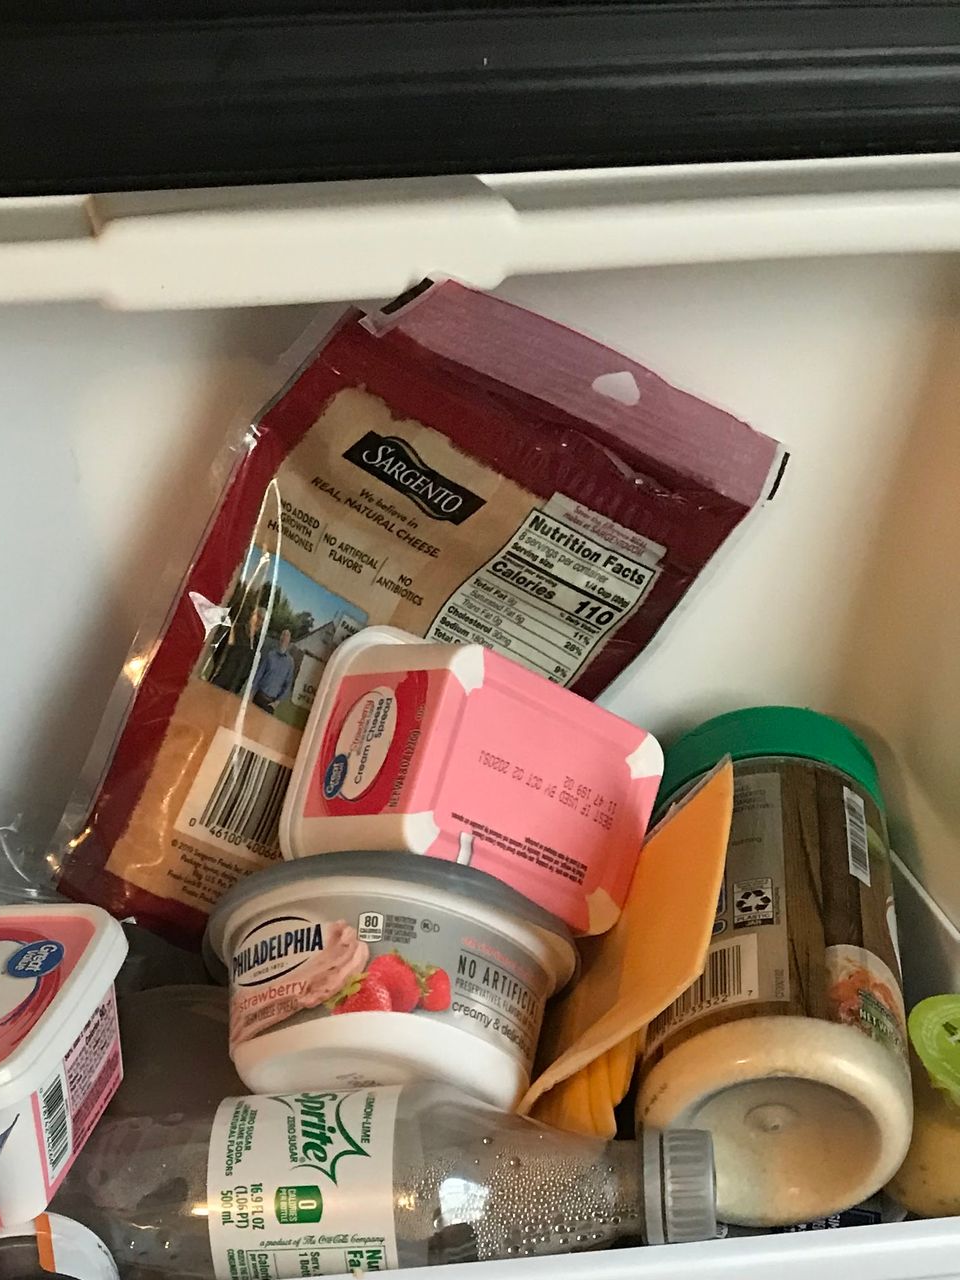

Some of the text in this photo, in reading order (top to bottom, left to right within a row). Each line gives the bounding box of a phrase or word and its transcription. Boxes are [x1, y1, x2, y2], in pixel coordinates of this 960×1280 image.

[362, 444, 463, 513] SARGENTO
[280, 498, 320, 529] NO ADDED
[344, 498, 395, 533] NATURAL
[359, 488, 418, 529] We believe in
[280, 513, 312, 537] GROWTH
[323, 533, 379, 570] NO ARTIFICIAL
[328, 550, 363, 574] FLAVORS
[518, 532, 609, 583] 8 servings per container
[529, 515, 646, 585] Nutrition Facts
[398, 574, 413, 587] NO
[511, 542, 613, 599] Serving size 1/4 Cup
[376, 577, 424, 606] ANTIBIOTICS
[473, 578, 493, 592] Total
[492, 589, 508, 600] Fat
[492, 561, 614, 626] Calories 110
[480, 607, 494, 619] Fat
[502, 606, 516, 617] Fat
[433, 628, 453, 643] Total
[440, 616, 470, 637] Sodium
[447, 605, 492, 634] Cholesterol
[553, 666, 568, 678] 9%
[375, 698, 392, 738] Spread
[354, 699, 384, 784] Cream Cheese
[512, 766, 524, 781] 02
[525, 774, 543, 790] OCT
[558, 790, 579, 809] USED
[189, 818, 197, 827] 0
[209, 828, 242, 846] 46100
[364, 916, 378, 927] 80
[232, 923, 323, 983] PHILADELPHIA
[457, 955, 476, 978] NO
[239, 980, 307, 1013] strawberry
[451, 1002, 500, 1030] creamy &
[244, 1109, 258, 1151] ZERO SUGAR
[287, 1116, 298, 1163] ZERO SUGAR
[295, 1092, 337, 1163] Sprite
[225, 1139, 235, 1176] FLAVORS
[235, 1141, 243, 1164] SODA
[220, 1190, 233, 1209] 500
[250, 1182, 263, 1202] 16.9
[287, 1188, 297, 1222] CALORIES
[298, 1199, 317, 1209] 0
[236, 1212, 249, 1229] PT)
[252, 1217, 265, 1230] OZ
[280, 1201, 289, 1222] BOTTLE
[265, 1239, 291, 1247] product
[292, 1238, 300, 1246] of
[350, 1235, 385, 1244] Company
